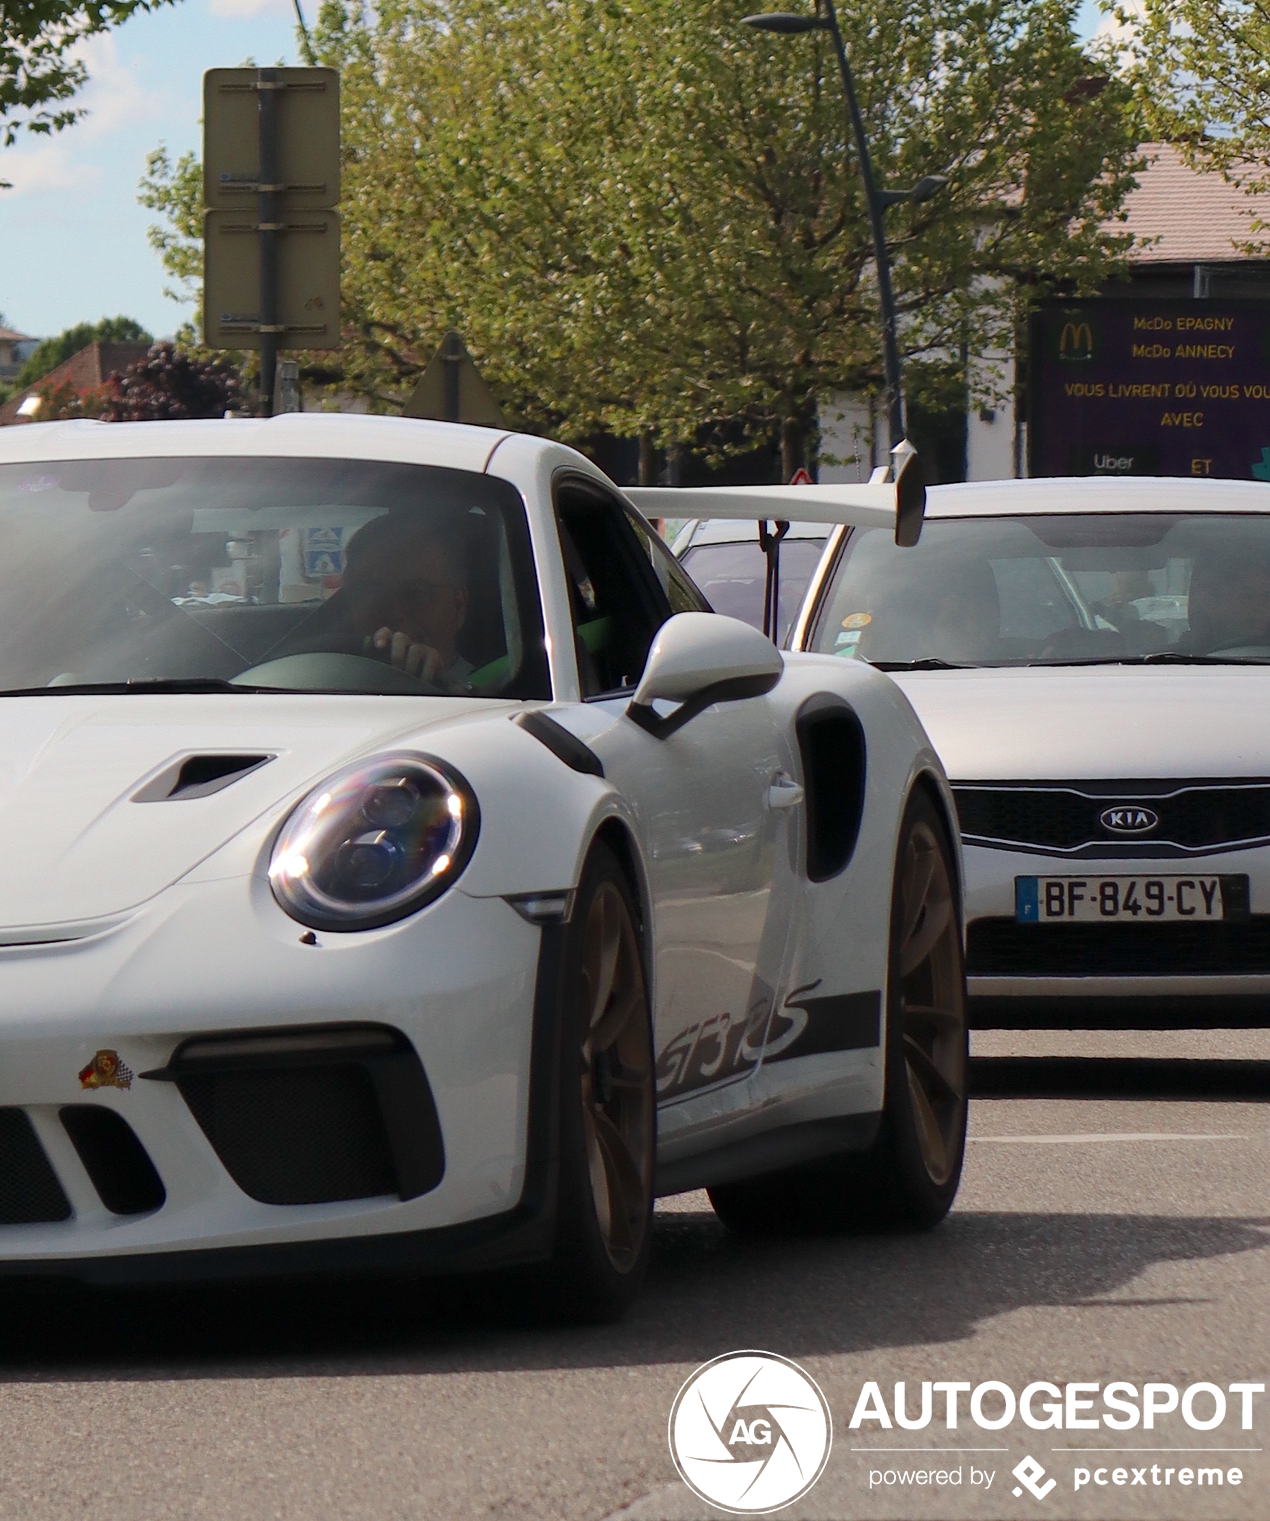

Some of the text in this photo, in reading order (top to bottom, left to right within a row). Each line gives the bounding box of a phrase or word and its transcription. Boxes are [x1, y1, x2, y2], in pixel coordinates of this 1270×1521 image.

[1133, 317, 1235, 331] McDo EPAGNY
[1132, 344, 1235, 359] McDo ANNECY
[1064, 383, 1105, 397] VOUS
[1109, 383, 1171, 398] LIVRENT
[1175, 381, 1197, 398] OÙ
[1200, 385, 1239, 398] VOUS
[1160, 412, 1204, 427] AVEC
[1094, 454, 1213, 474] Uber ET
[1110, 811, 1148, 826] KIA
[1045, 880, 1218, 918] BF-849-CY
[1024, 904, 1032, 915] F
[656, 978, 823, 1093] GT3 RS
